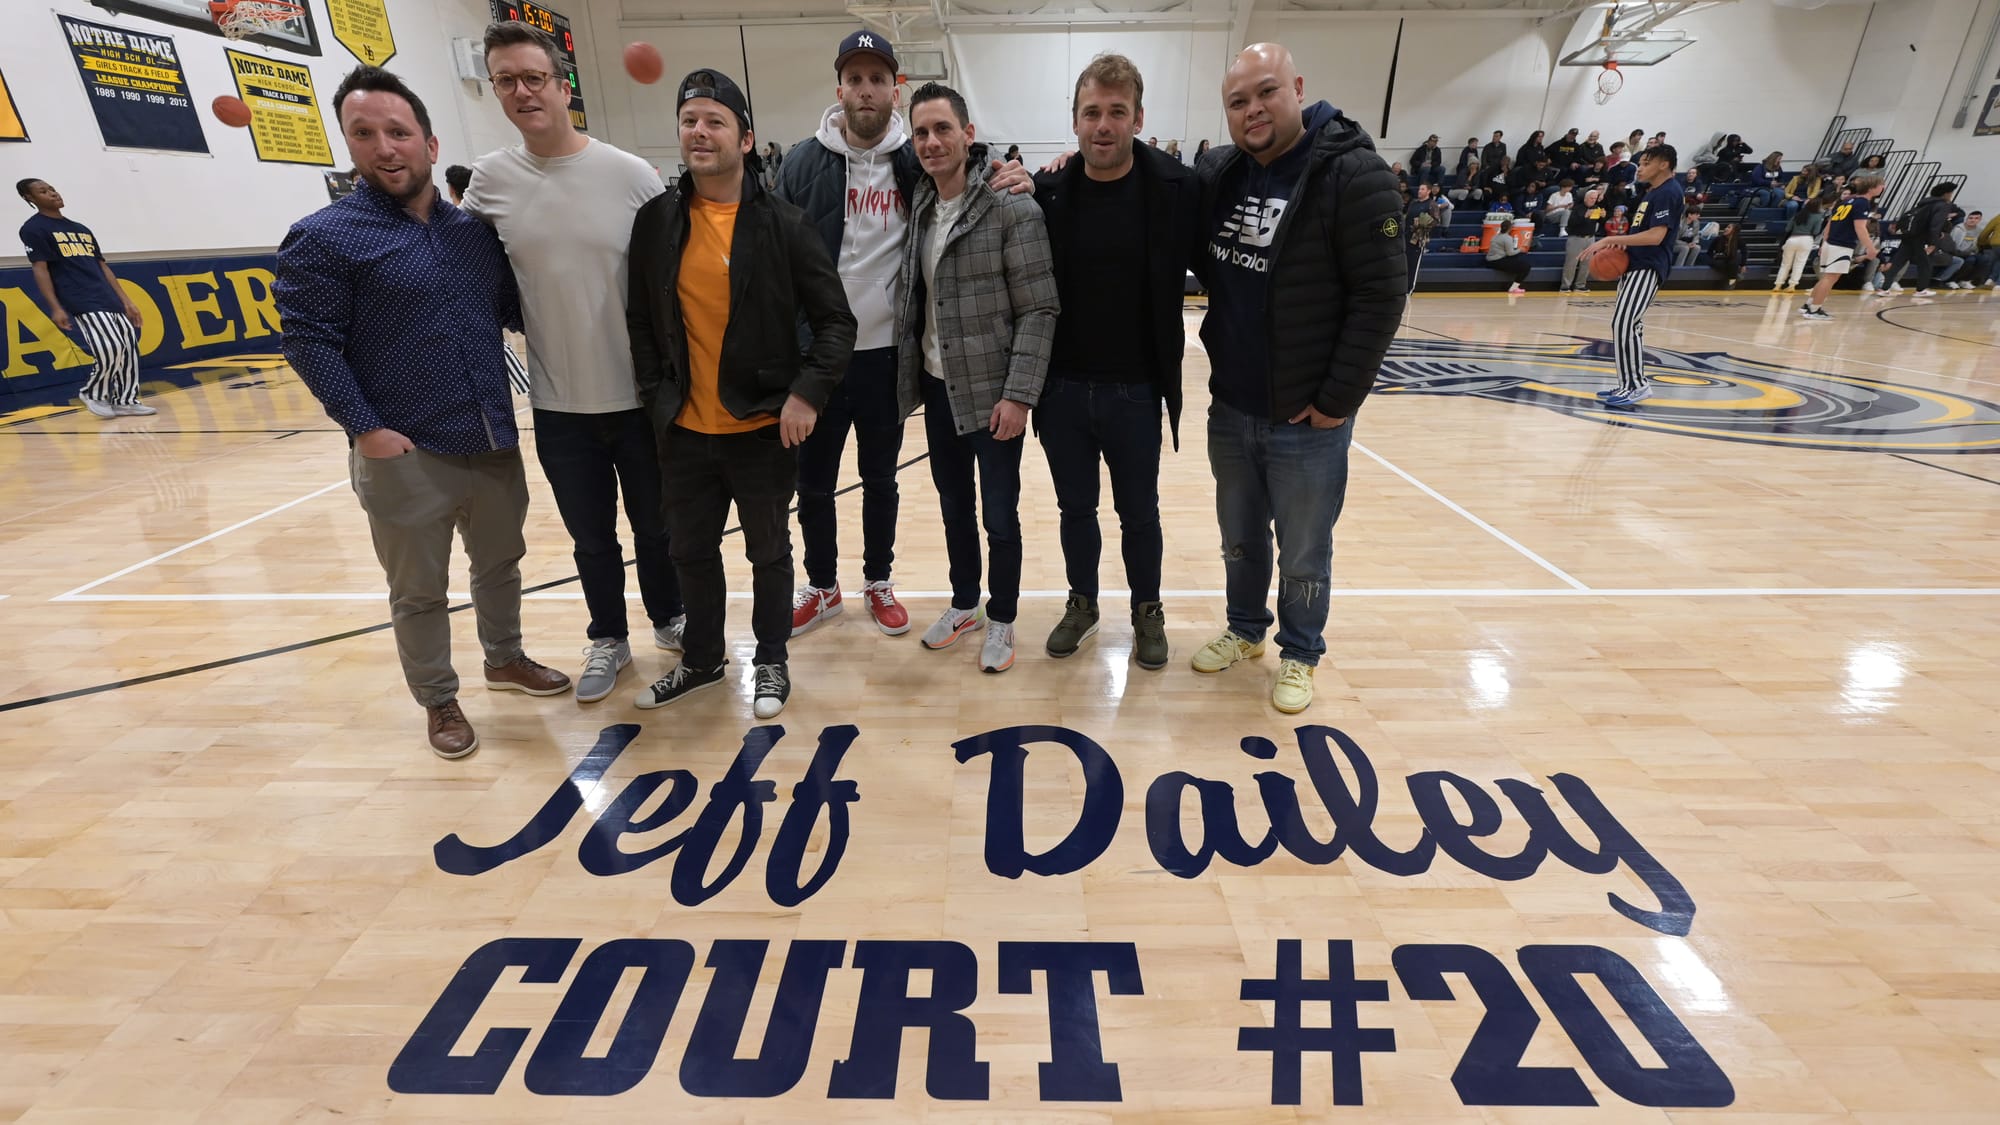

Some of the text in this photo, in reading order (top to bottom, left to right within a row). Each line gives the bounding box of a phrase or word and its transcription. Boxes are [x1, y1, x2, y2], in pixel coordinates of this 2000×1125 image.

[523, 3, 554, 33] 15:00
[64, 22, 176, 64] NOTRE DAME
[564, 31, 574, 51] 0
[857, 34, 874, 49] NY
[100, 48, 121, 59] HIGH
[95, 60, 170, 79] GIRLS TRACK & FIELD
[234, 58, 309, 88] NOTRE DAME
[95, 73, 177, 93] LEAGUE CHAMPIONS
[94, 87, 188, 107] 1989 1990 1999 2012
[261, 89, 279, 99] TRACK
[284, 93, 299, 102] FIELD
[1831, 204, 1853, 222] 20
[58, 243, 96, 257] DAILE
[1232, 246, 1269, 273] bala
[434, 723, 1696, 937] Jeff Dailey
[388, 938, 1735, 1108] COURT #20
